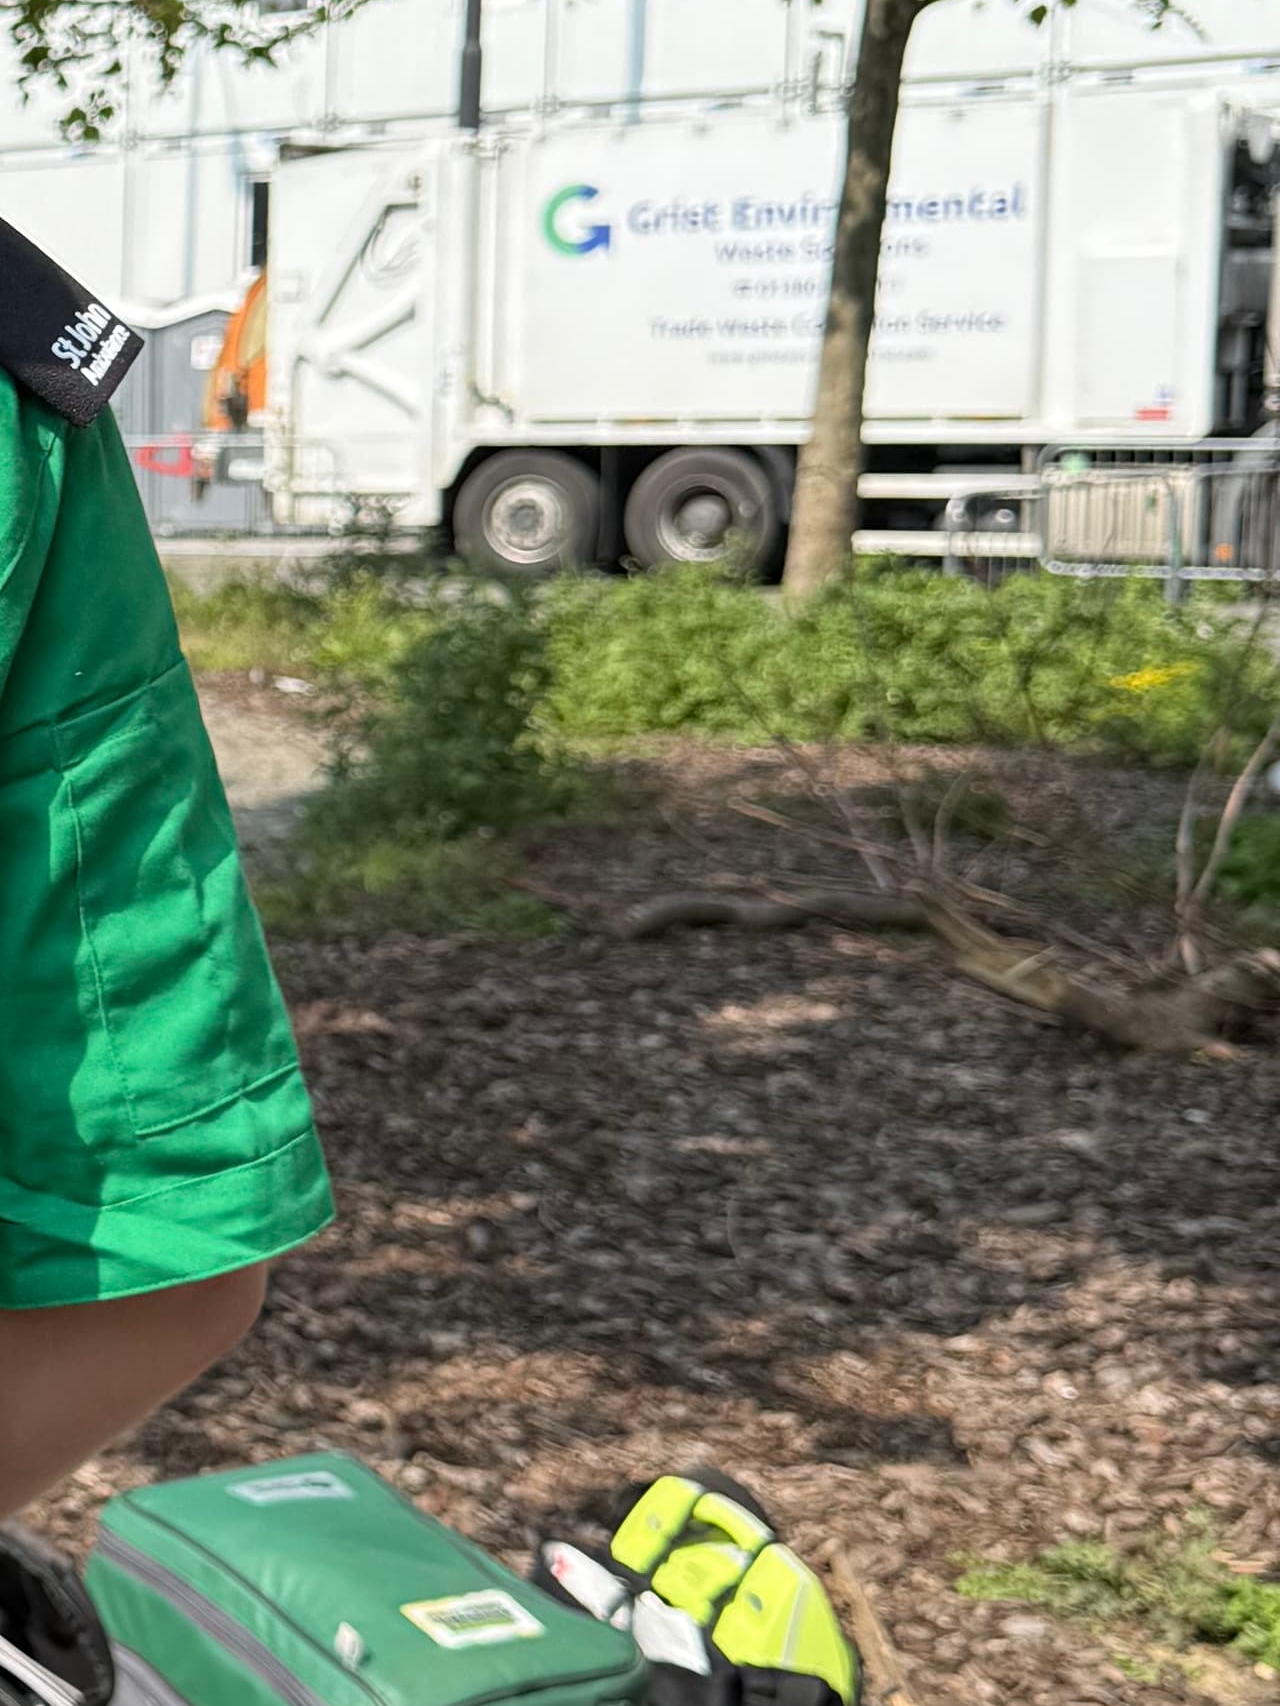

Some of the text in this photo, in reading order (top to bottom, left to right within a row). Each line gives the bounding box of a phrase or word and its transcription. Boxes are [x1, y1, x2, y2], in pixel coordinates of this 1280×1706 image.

[627, 183, 1028, 235] Grist Envirmental
[50, 302, 113, 371] St John
